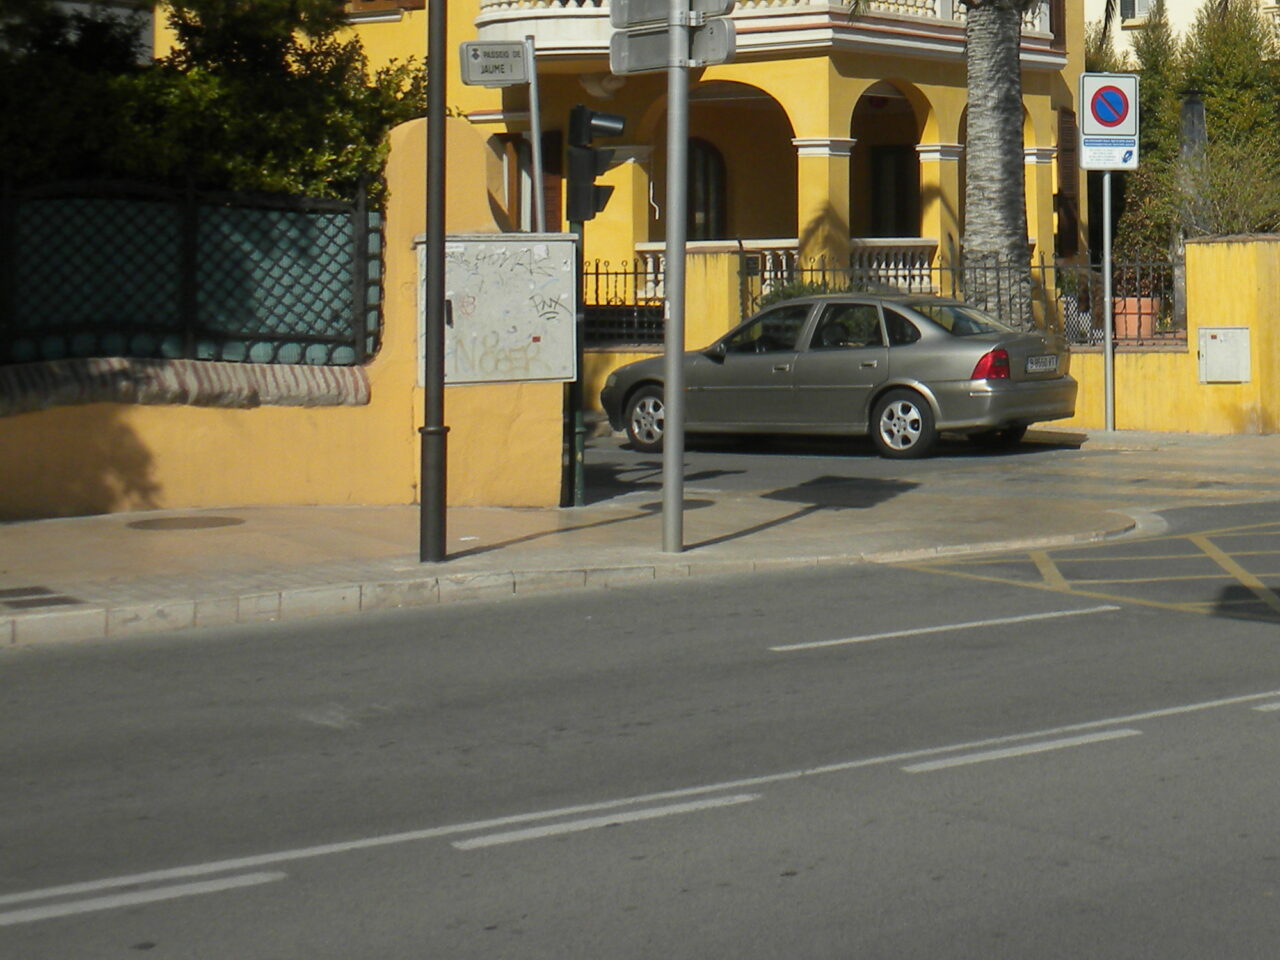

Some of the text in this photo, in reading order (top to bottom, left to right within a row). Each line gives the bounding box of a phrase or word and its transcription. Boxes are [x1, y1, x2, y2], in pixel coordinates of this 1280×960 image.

[483, 50, 521, 59] PASSEIG DE
[481, 64, 505, 75] JAUME
